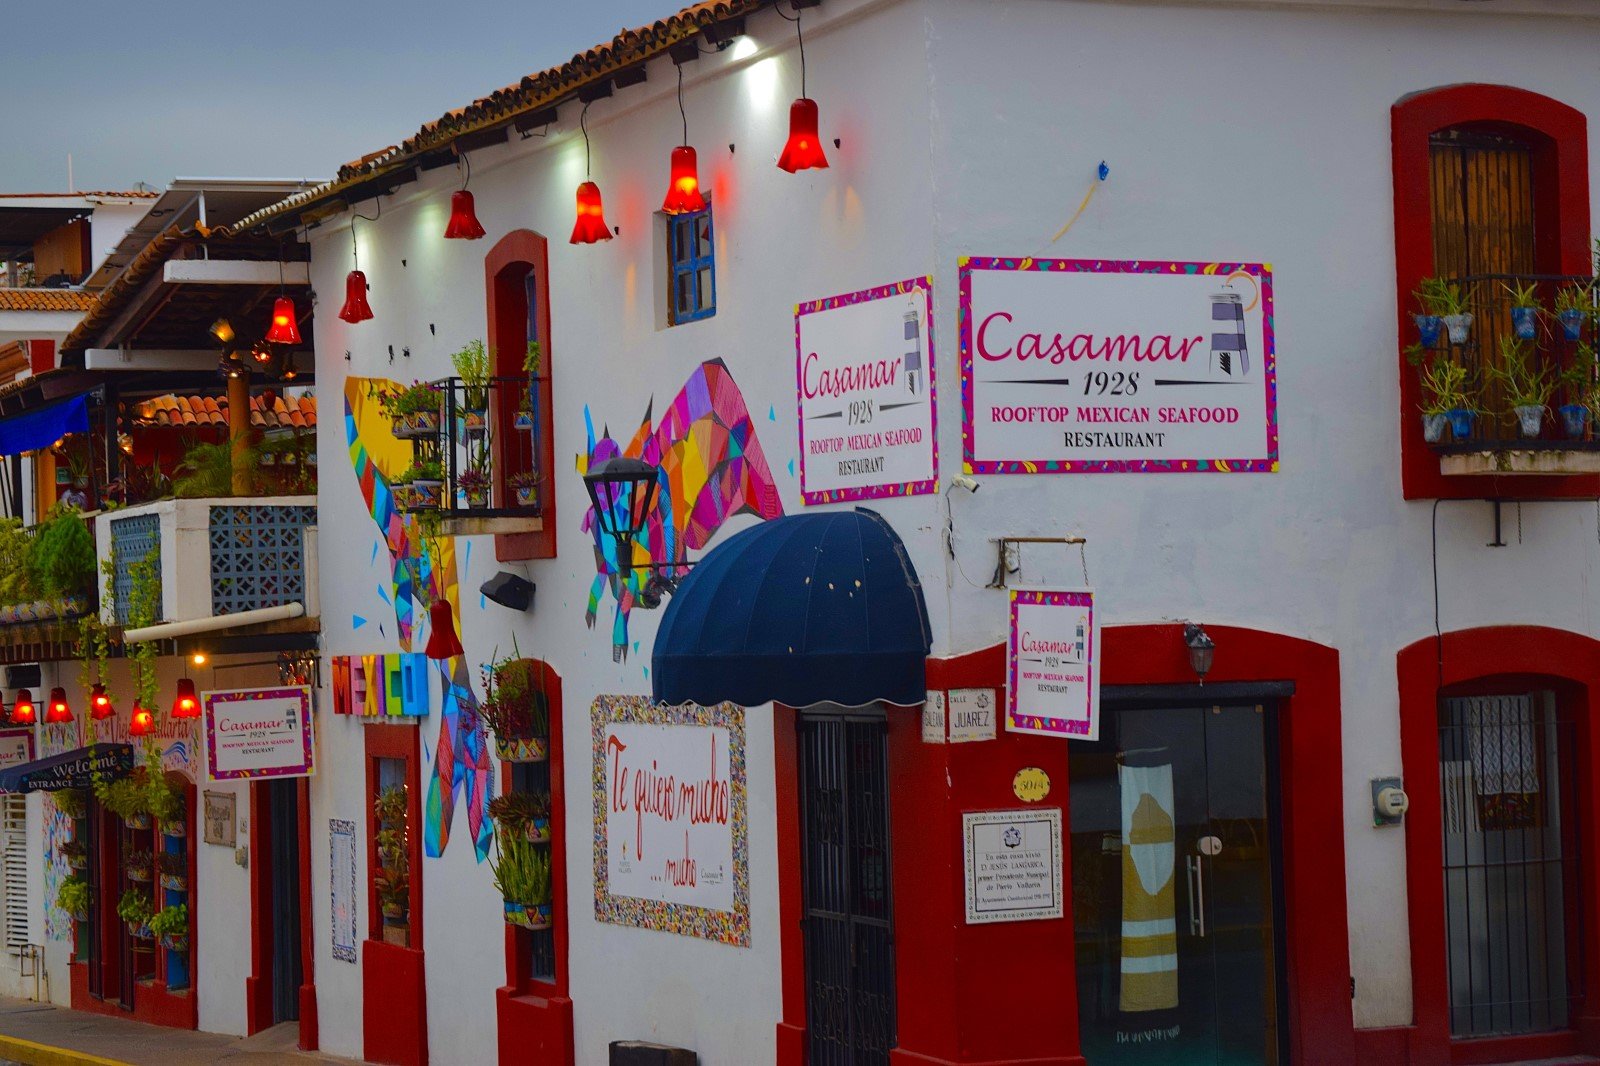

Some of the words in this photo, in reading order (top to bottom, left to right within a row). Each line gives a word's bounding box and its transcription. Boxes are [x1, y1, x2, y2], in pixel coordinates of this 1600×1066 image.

[976, 312, 1203, 364] Casamar
[803, 352, 901, 400] Casamar
[1083, 371, 1141, 396] 1928
[848, 400, 873, 426] 1928
[991, 407, 1069, 423] ROOFTOP
[1076, 407, 1150, 423] MEXICAN
[1157, 407, 1239, 424] SEAFOOD
[810, 437, 844, 454] ROOFTOP
[847, 432, 882, 451] MEXICAN
[884, 427, 922, 447] SEAFOOD
[1064, 432, 1165, 448] RESTAURANT
[838, 456, 884, 476] RESTAURANT
[1021, 631, 1074, 654] Casamar
[332, 653, 429, 717] MEXICO
[1037, 684, 1068, 693] RESTAURANT
[220, 718, 284, 732] Casamar
[954, 711, 989, 728] JUAREZ
[29, 780, 73, 788] ENTRANCE
[89, 771, 113, 779] OEN
[608, 734, 628, 813] Te
[635, 760, 675, 861] quiero
[676, 732, 728, 825] mucho
